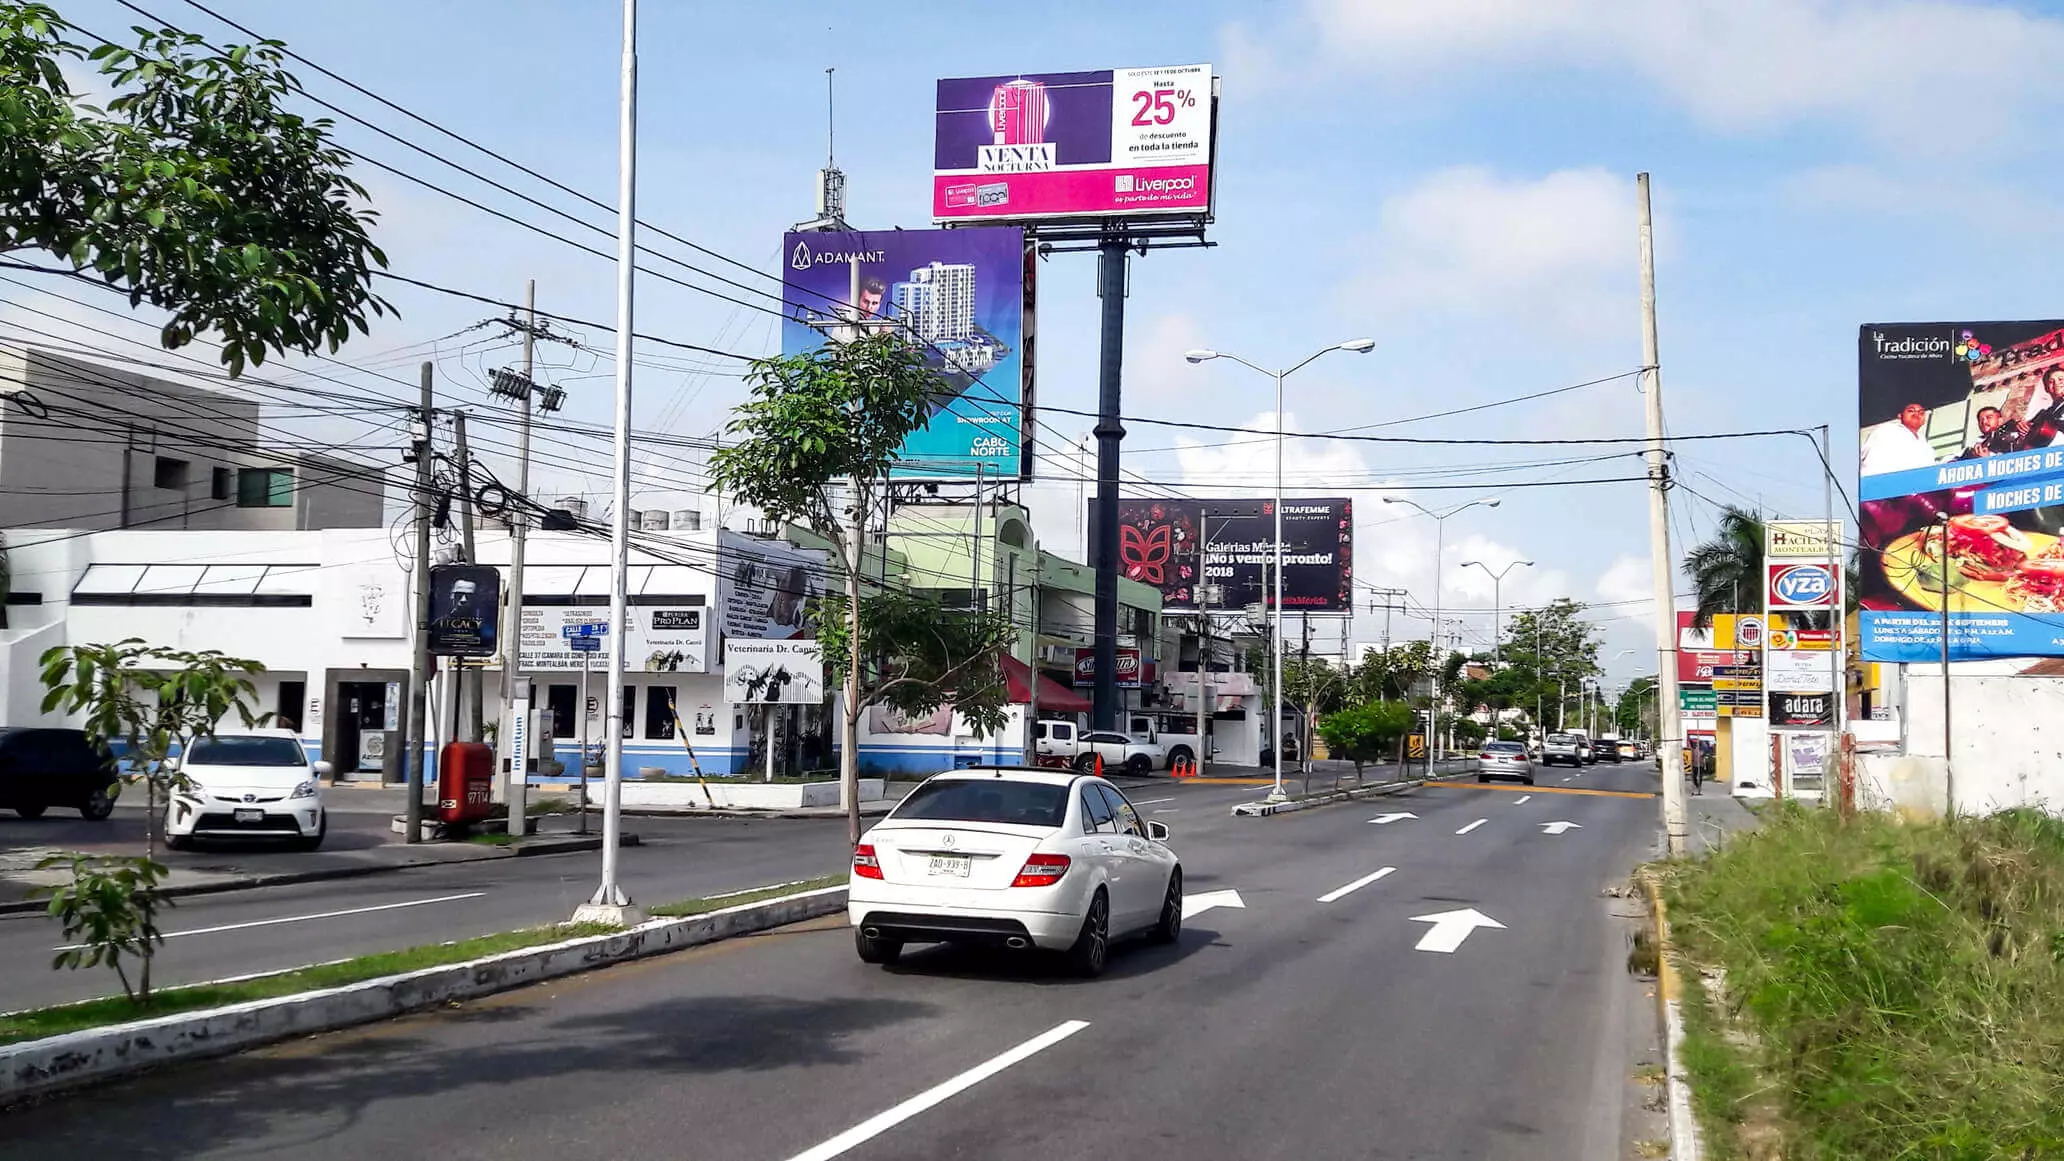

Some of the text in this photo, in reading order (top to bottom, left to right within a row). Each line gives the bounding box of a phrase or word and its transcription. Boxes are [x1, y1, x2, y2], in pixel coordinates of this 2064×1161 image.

[1149, 131, 1187, 139] descuento
[1140, 142, 1160, 151] toda
[1162, 141, 1170, 150] la
[1171, 140, 1199, 149] tienda
[984, 146, 1049, 162] VENTA
[984, 162, 1049, 172] NOCTURNA
[1135, 175, 1194, 193] Liverpool
[1873, 330, 1884, 339] La
[1873, 336, 1950, 353] Tradición
[973, 437, 1007, 447] CABO
[970, 447, 1010, 456] NORTE
[1938, 451, 2064, 484] AHORA NOCHES DE
[1986, 484, 2063, 510] NOCHES DE
[1774, 533, 1839, 545] HACIENA
[1235, 554, 1280, 564] vemo
[1281, 553, 1333, 566] pronto!
[1205, 566, 1234, 577] 2018
[1784, 577, 1826, 597] yza
[653, 617, 698, 625] PRO PLAN
[728, 644, 774, 653] Veterinaria
[776, 644, 790, 653] Dr.
[1785, 696, 1823, 713] adara
